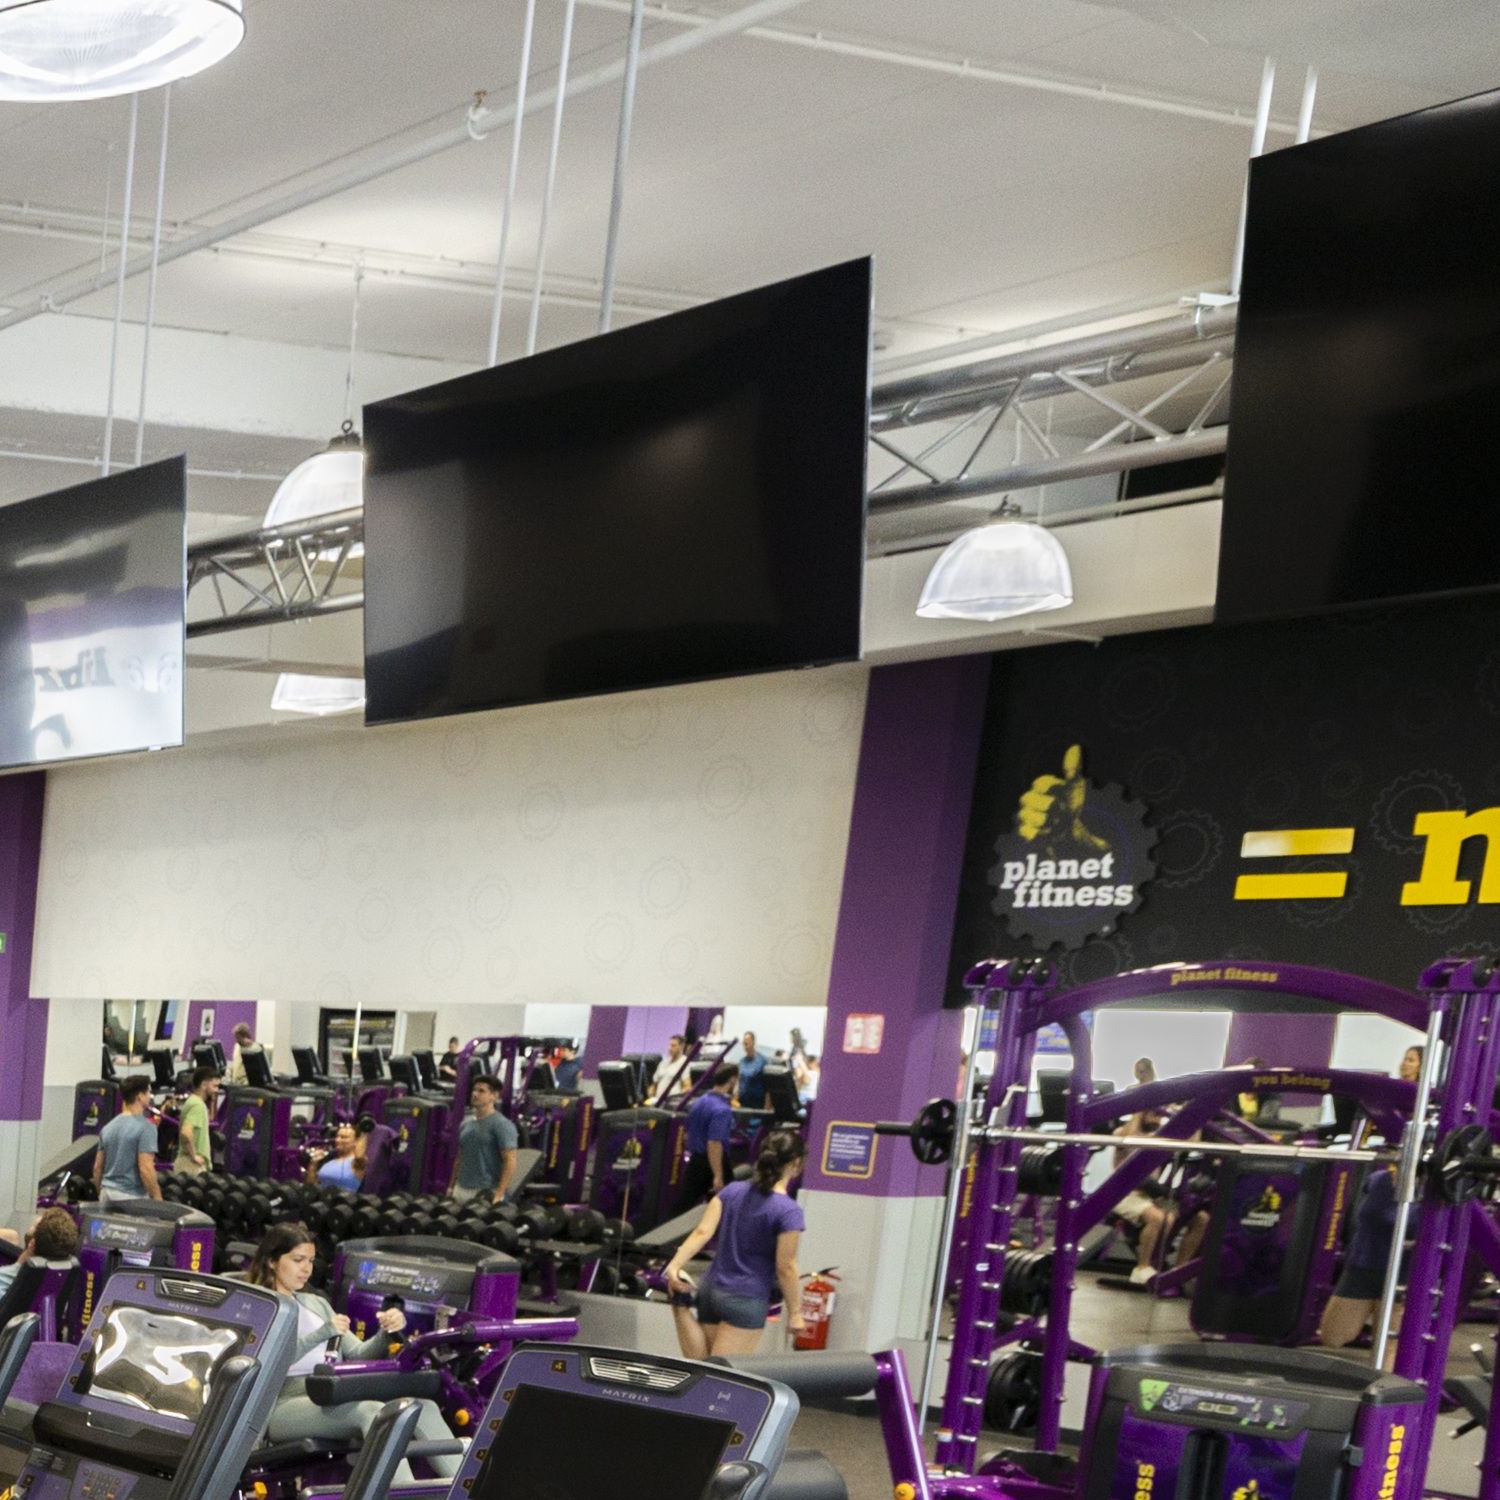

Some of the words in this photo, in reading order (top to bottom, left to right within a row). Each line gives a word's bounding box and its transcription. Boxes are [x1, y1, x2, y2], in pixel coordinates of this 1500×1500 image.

[1000, 852, 1114, 889] planet
[1012, 880, 1134, 907] fitness
[1171, 969, 1222, 986] planet
[1223, 967, 1278, 983] fitness
[1281, 1073, 1331, 1090] belong
[602, 1387, 652, 1403] MATRIX
